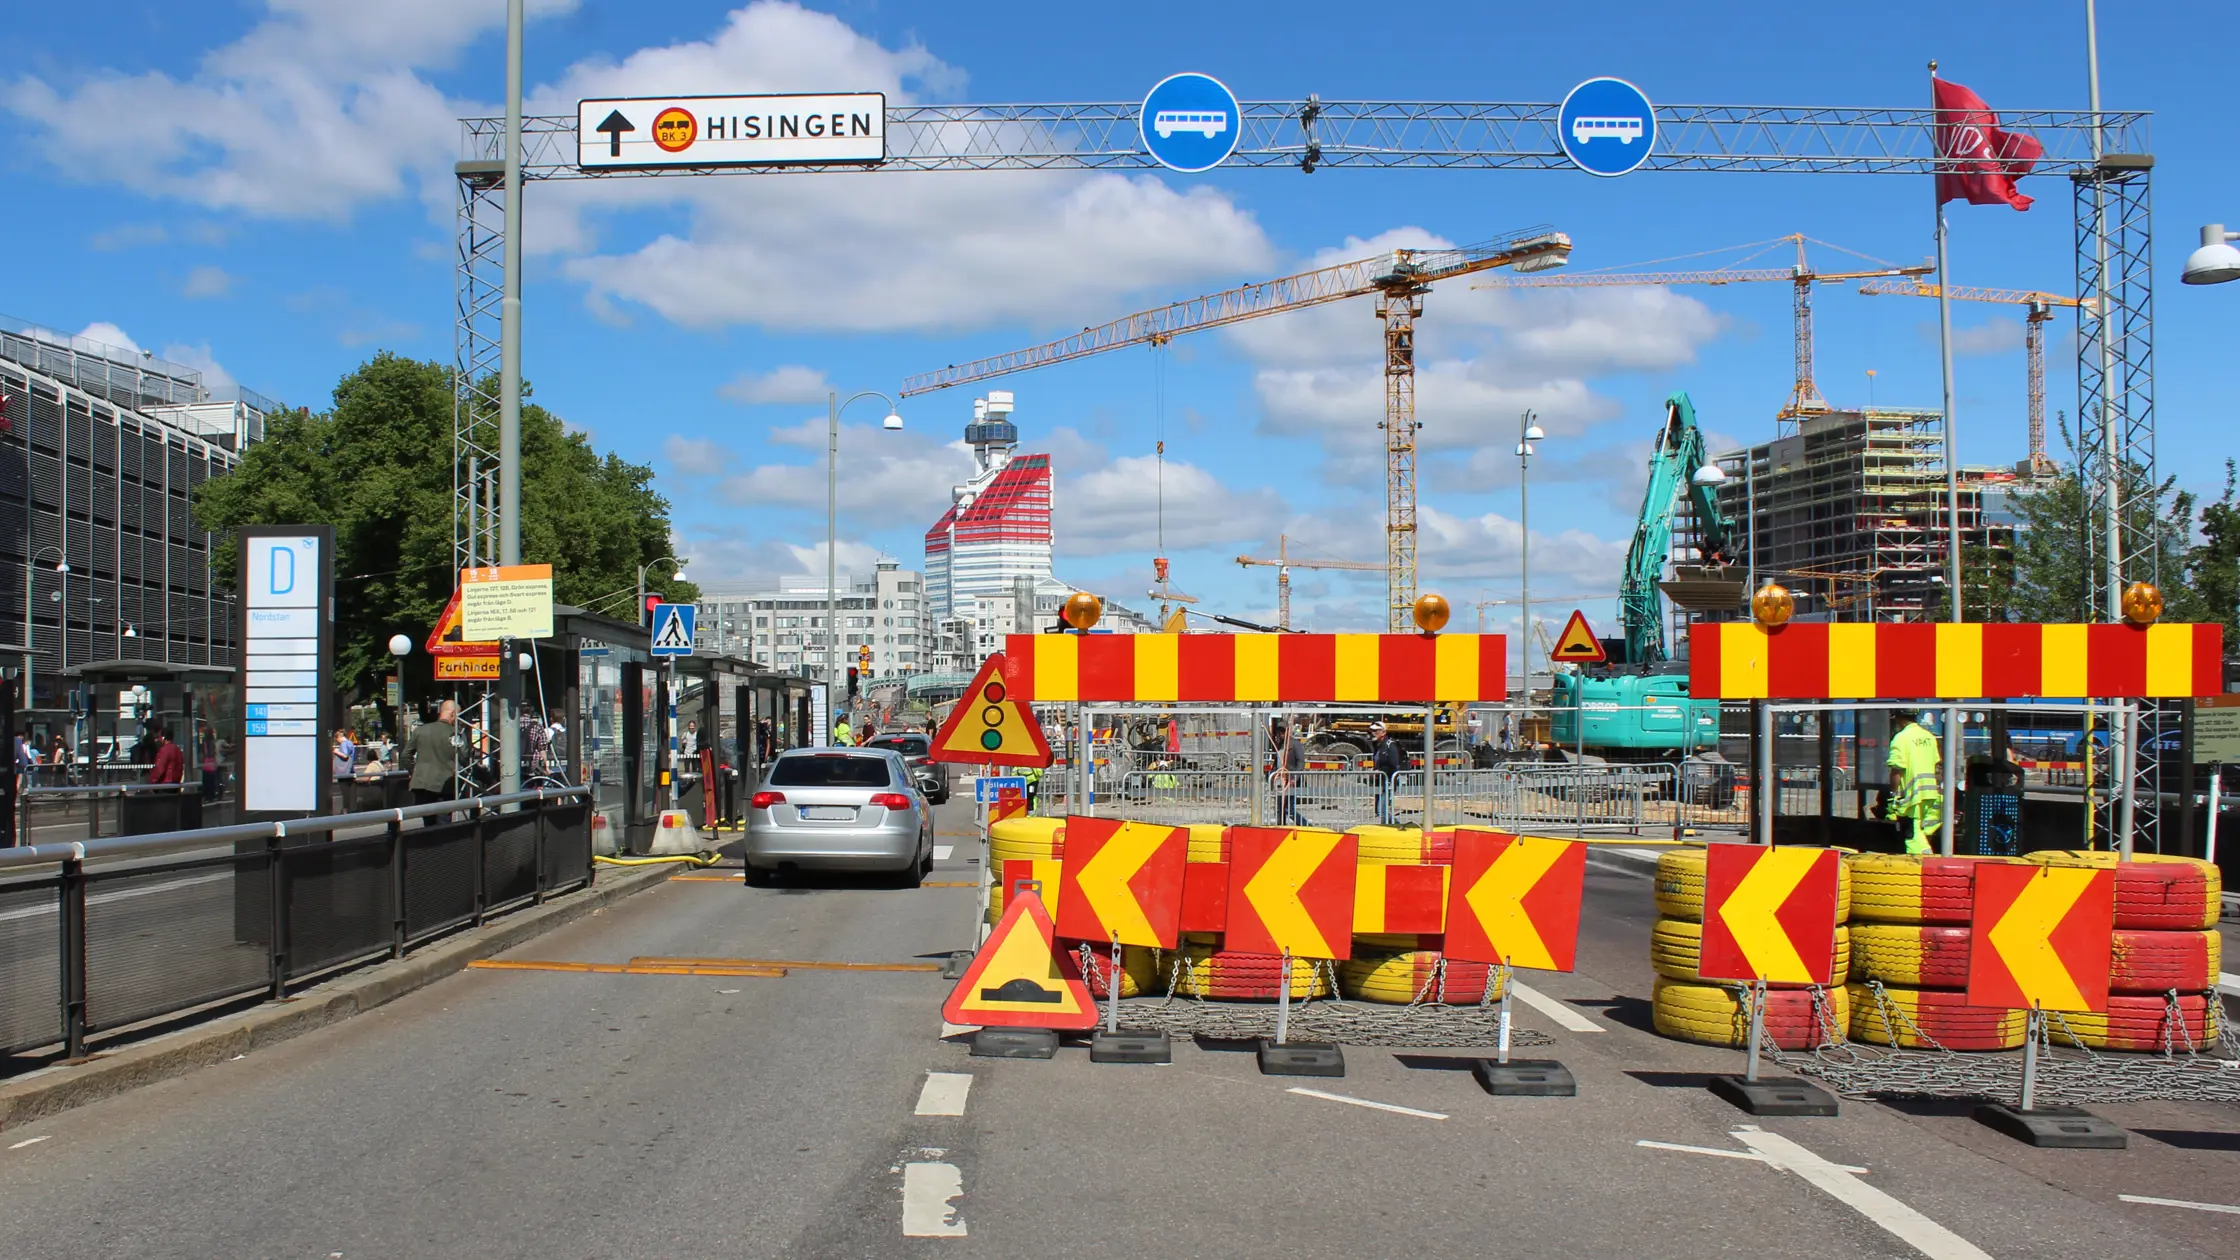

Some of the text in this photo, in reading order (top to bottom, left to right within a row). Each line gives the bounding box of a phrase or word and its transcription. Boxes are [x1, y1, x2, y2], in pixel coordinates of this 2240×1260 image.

[708, 114, 870, 138] HISINGEN
[661, 132, 687, 141] BK 3
[270, 546, 295, 595] D
[252, 612, 290, 621] Nordstan
[438, 662, 500, 672] Farthinder
[252, 723, 266, 733] 159
[1912, 738, 1932, 746] VAKT
